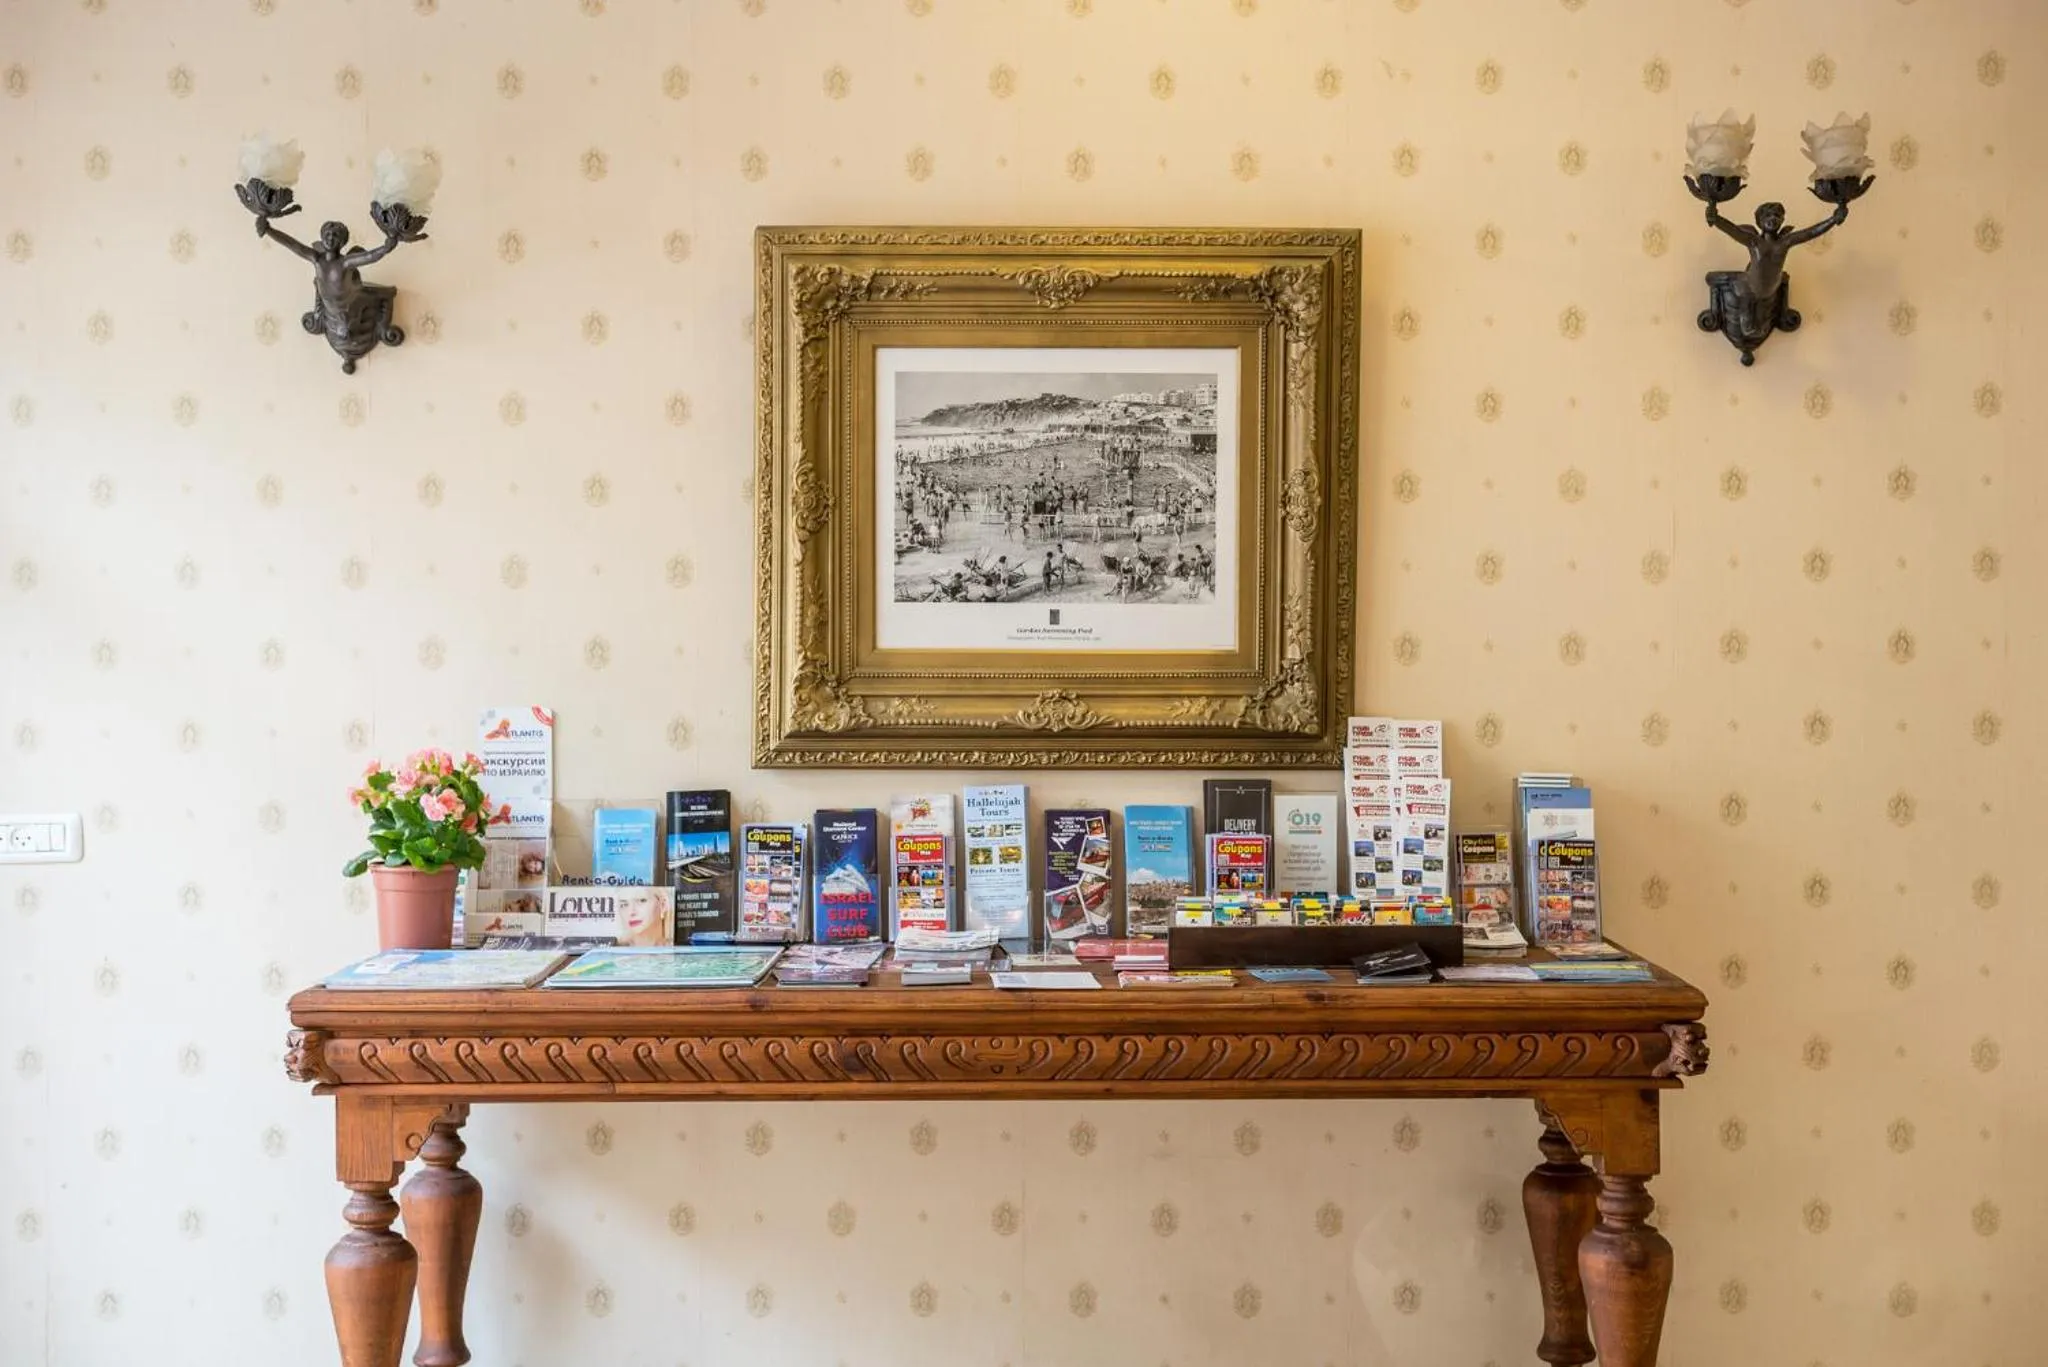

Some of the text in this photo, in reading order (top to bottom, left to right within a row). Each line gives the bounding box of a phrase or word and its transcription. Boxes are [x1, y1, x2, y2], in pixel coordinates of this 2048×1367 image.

[499, 768, 546, 777] ИЗРАИЛЮ
[966, 798, 1021, 809] Hallelujah
[979, 808, 1010, 817] Tours
[1224, 818, 1257, 831] DELIVERY
[747, 831, 792, 843] Coupons
[898, 841, 942, 851] Coupons
[1218, 844, 1263, 854] Coupons
[1548, 845, 1594, 857] Coupons
[969, 867, 997, 875] Private
[562, 874, 644, 886] Rent-a-Guide
[548, 891, 615, 913] Loren
[820, 892, 875, 904] ISRAEL
[827, 907, 869, 921] SURF
[827, 924, 869, 938] CLUB
